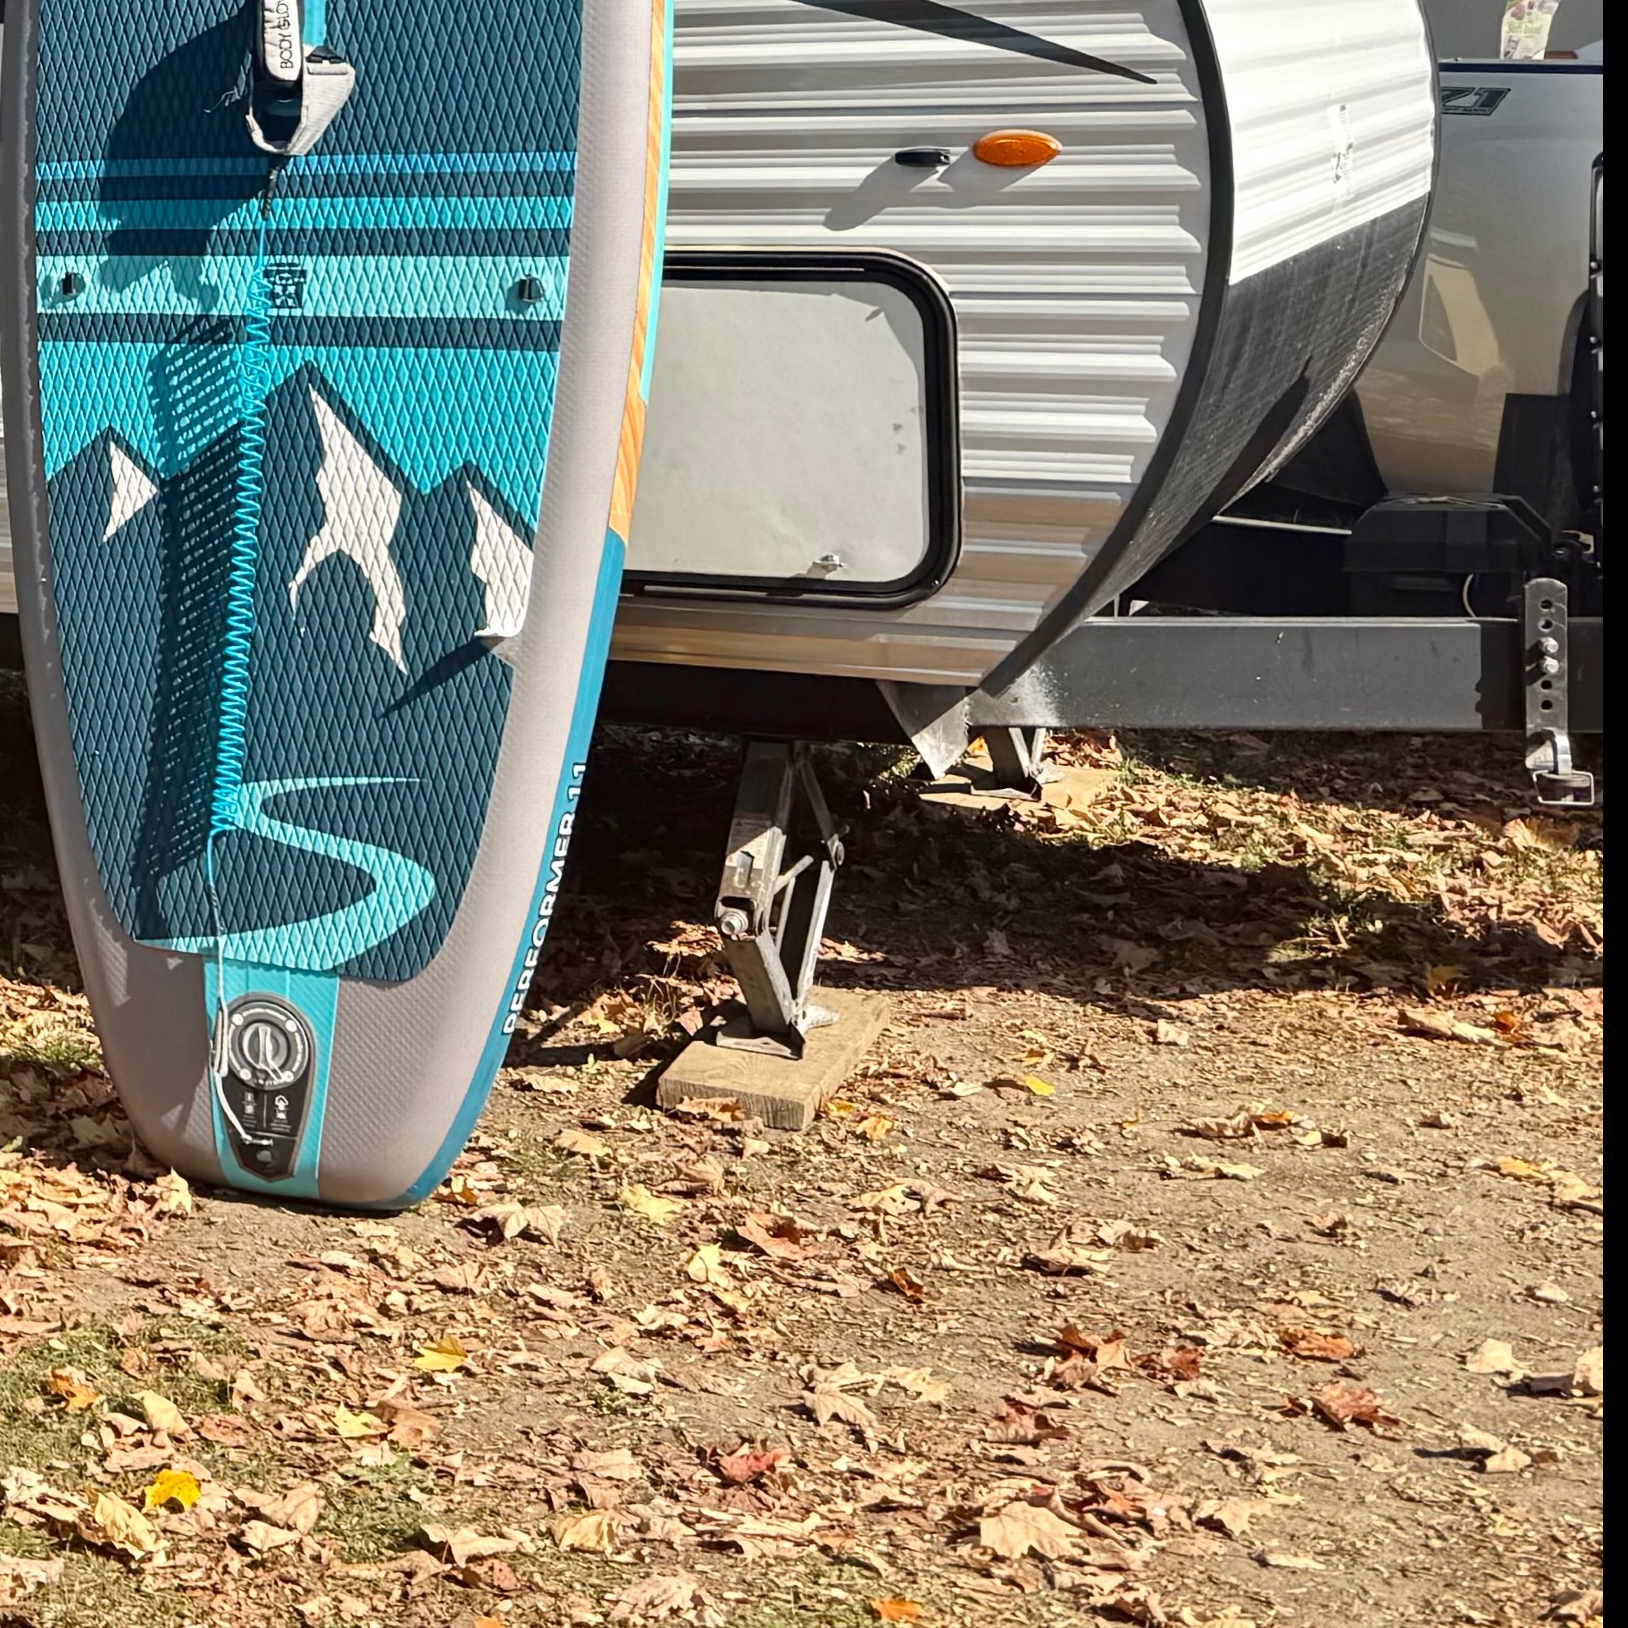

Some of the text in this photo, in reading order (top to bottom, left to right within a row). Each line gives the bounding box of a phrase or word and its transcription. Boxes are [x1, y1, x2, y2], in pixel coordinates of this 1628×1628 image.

[278, 33, 294, 69] BODY
[502, 762, 586, 1034] PERFORMER 11
